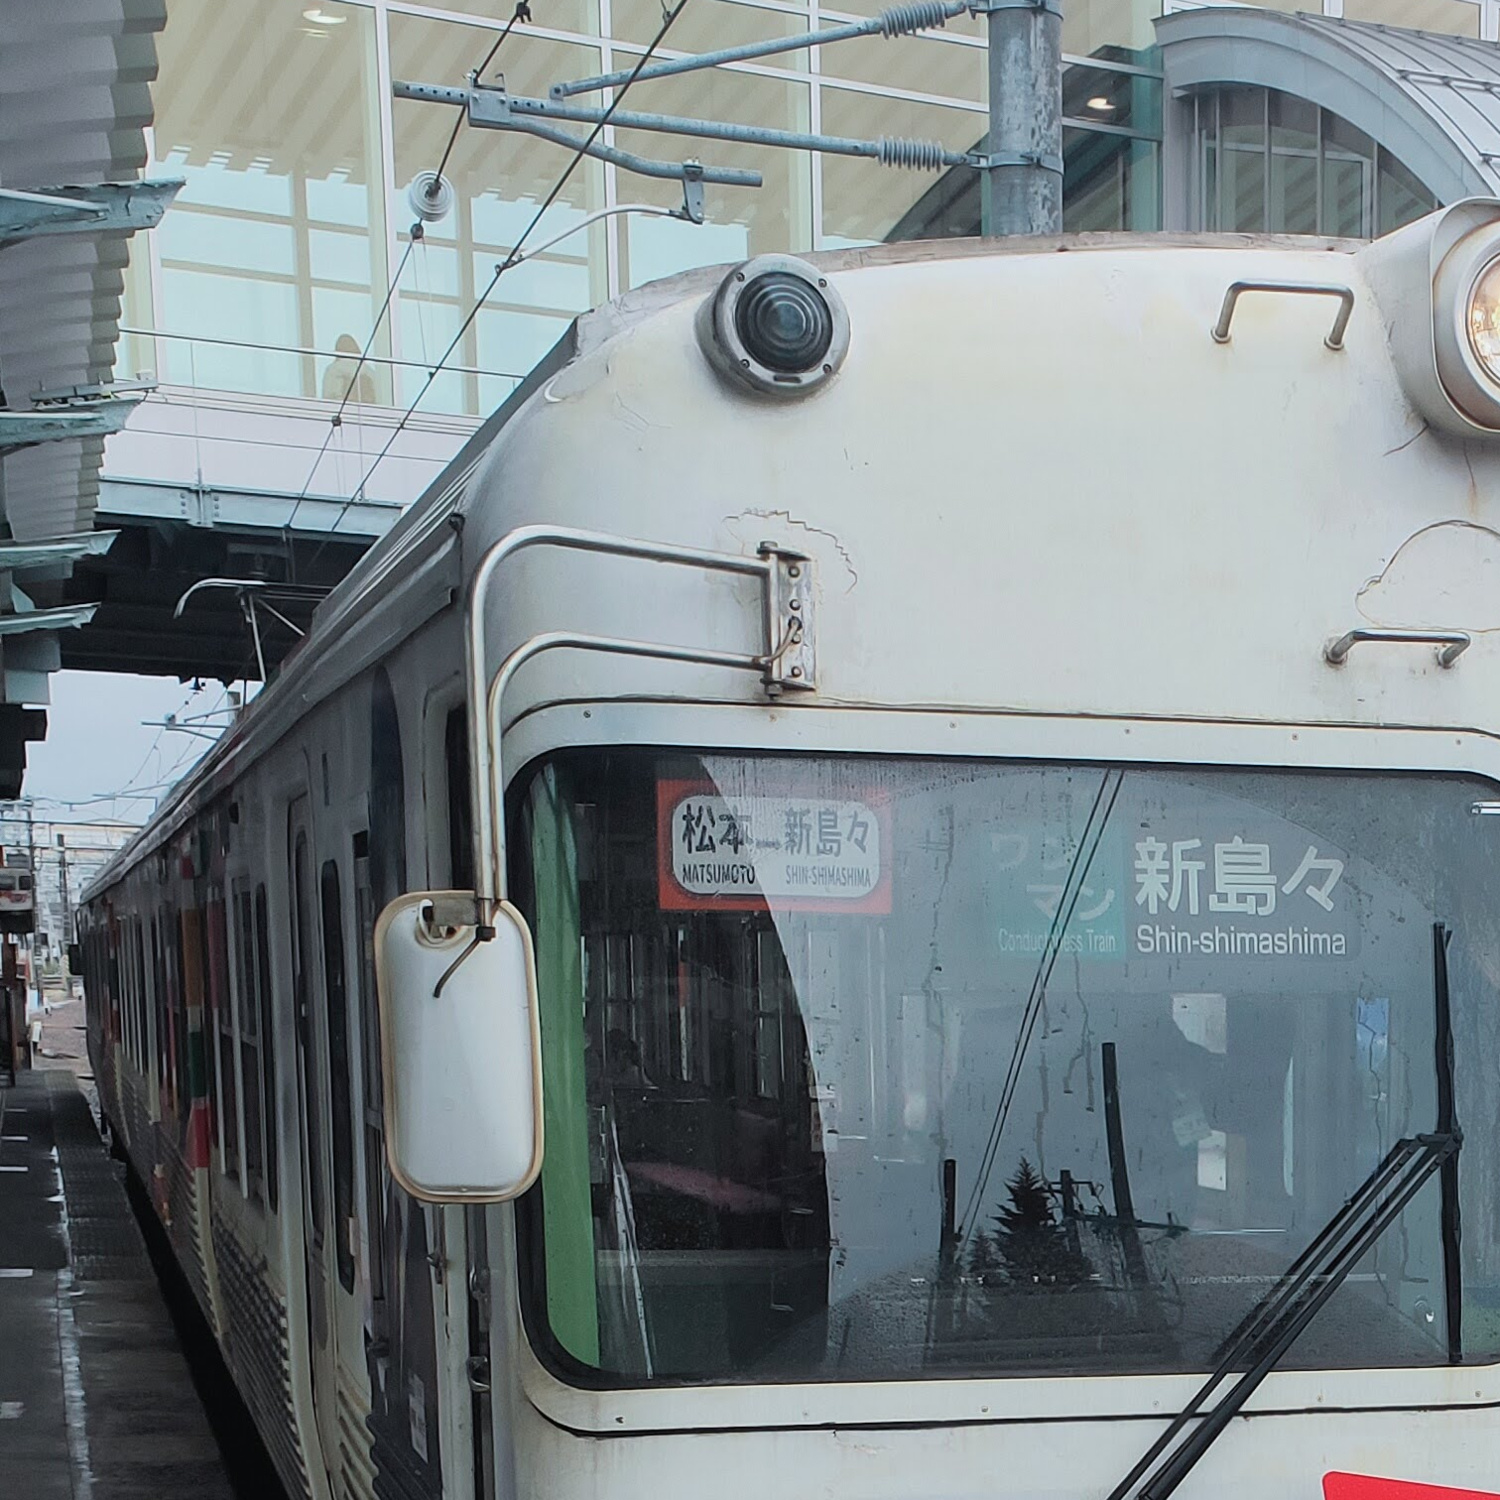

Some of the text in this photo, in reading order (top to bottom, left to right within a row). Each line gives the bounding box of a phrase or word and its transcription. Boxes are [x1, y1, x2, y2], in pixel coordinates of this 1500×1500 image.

[681, 803, 870, 858] 松本 新島々
[681, 863, 872, 888] MATSUMOTO SHIN-SHIMASHIMA
[1133, 834, 1346, 917] 新島々
[1086, 929, 1116, 953] Train
[1136, 924, 1347, 956] Shin-shimashima
